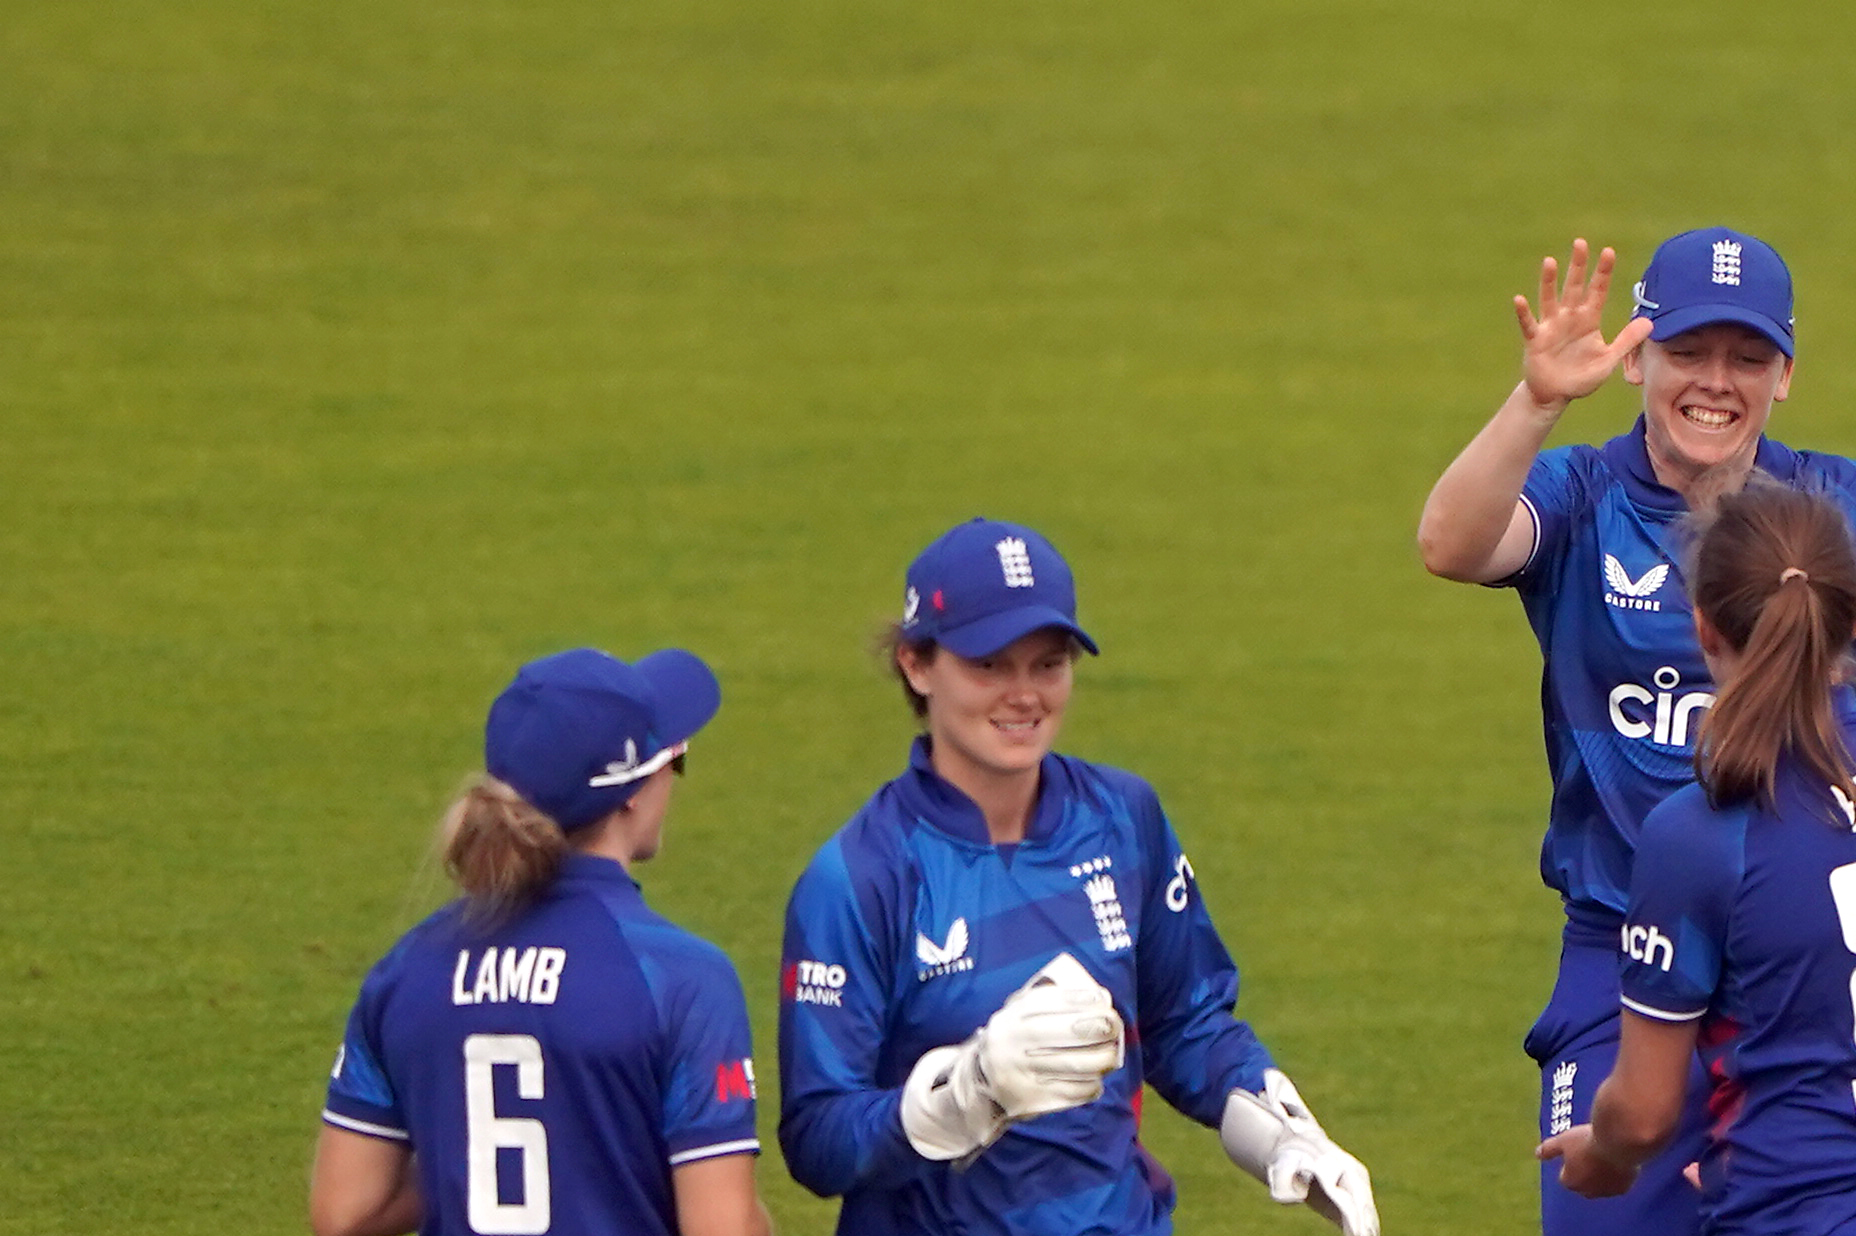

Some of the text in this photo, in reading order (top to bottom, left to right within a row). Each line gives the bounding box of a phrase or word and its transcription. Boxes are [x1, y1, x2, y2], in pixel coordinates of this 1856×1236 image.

[1604, 593, 1660, 612] CASTORE
[453, 947, 567, 1006] LAMB
[463, 1034, 551, 1236] 6
